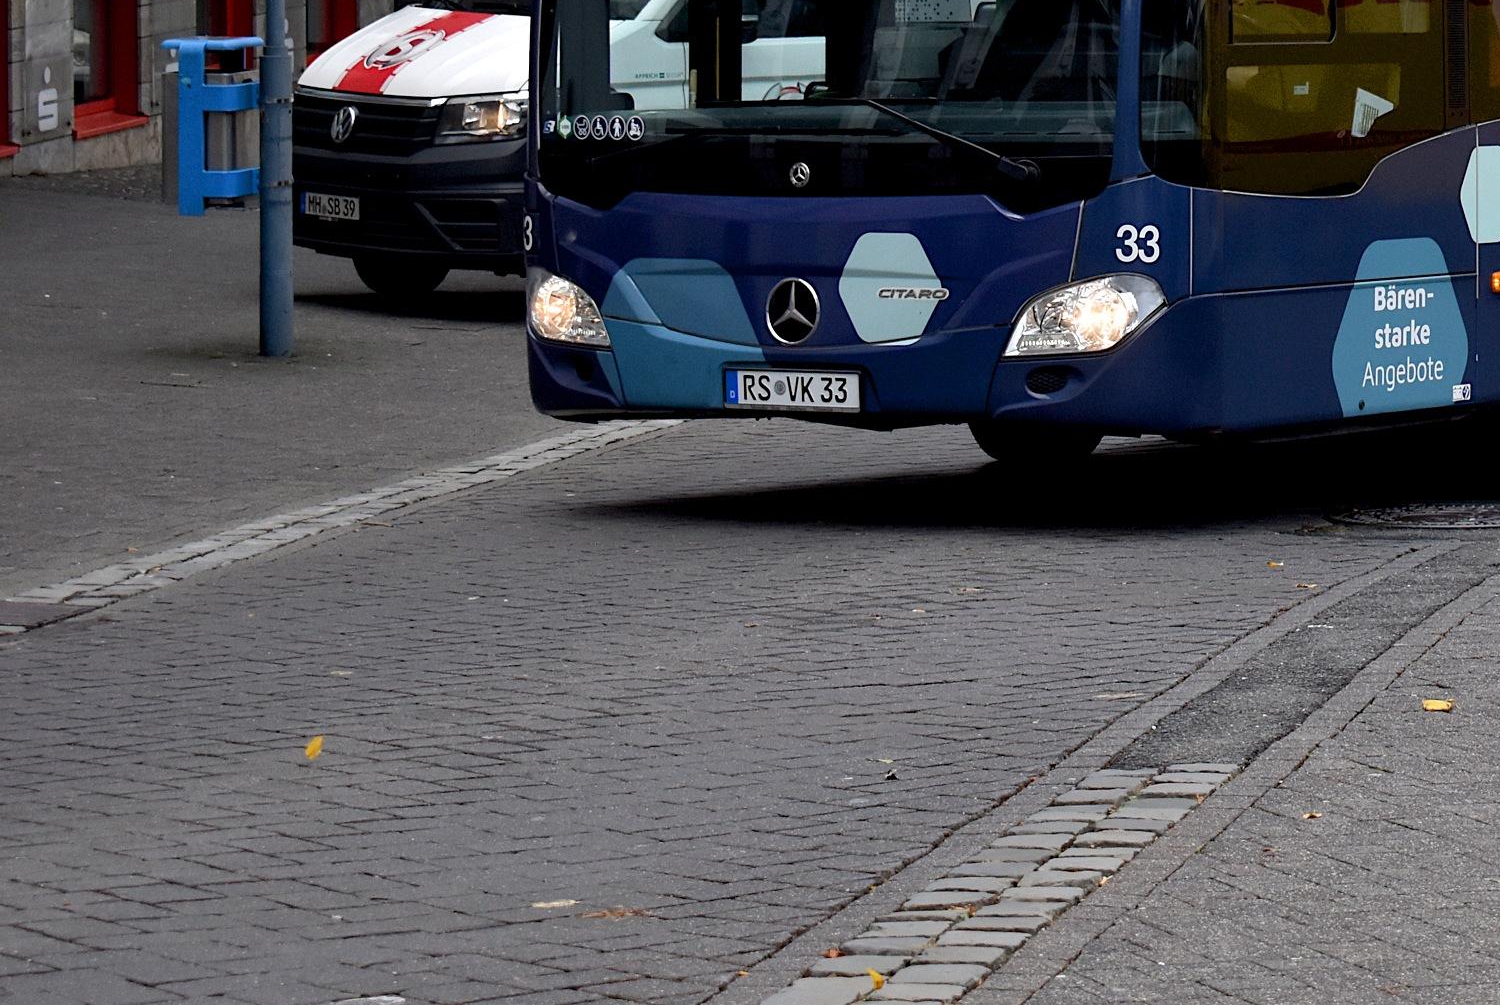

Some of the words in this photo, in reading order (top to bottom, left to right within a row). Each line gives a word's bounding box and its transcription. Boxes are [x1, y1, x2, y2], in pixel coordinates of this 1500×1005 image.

[307, 195, 321, 213] MH
[327, 197, 340, 215] SB
[343, 199, 355, 217] 39
[1115, 224, 1160, 263] 33
[878, 289, 948, 299] CITARO
[1373, 285, 1434, 312] Bären-
[1375, 320, 1431, 349] starke
[743, 374, 771, 401] RS
[786, 376, 814, 402] VK
[821, 377, 848, 403] 33
[1362, 356, 1444, 392] Angebote
